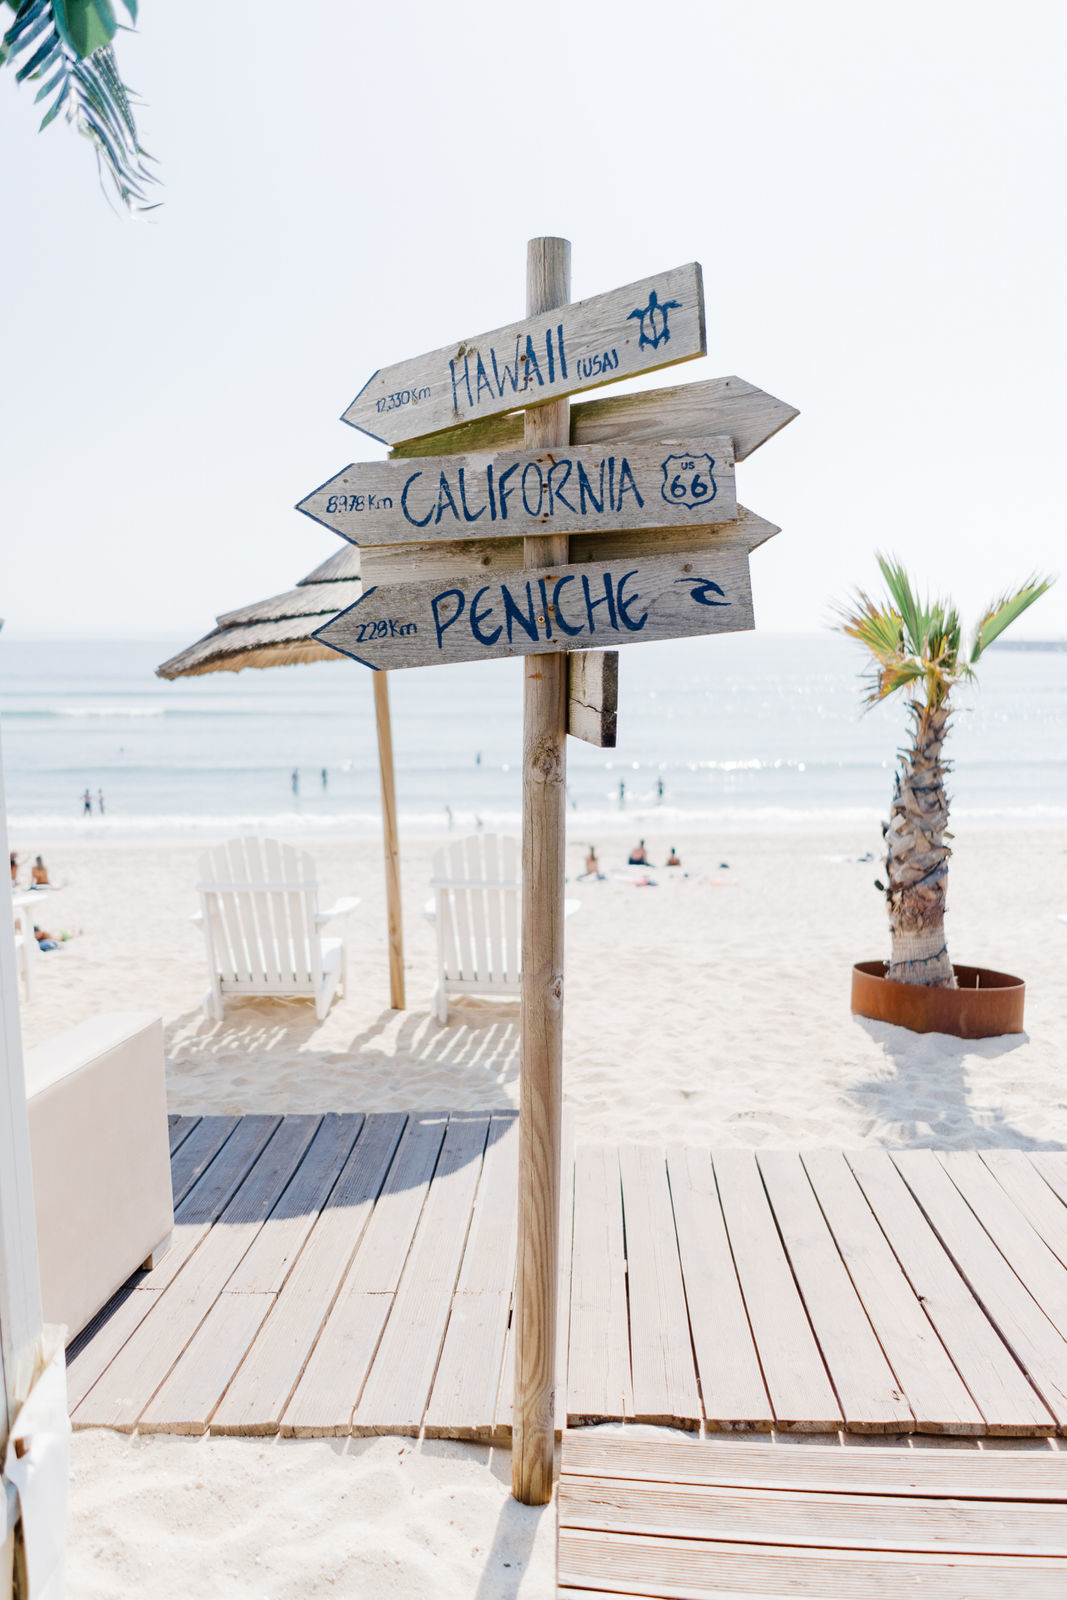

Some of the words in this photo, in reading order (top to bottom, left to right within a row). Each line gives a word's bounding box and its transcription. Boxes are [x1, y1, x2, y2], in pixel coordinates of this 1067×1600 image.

[449, 324, 568, 411] HAWAII
[577, 348, 619, 380] (USA)
[401, 456, 644, 527] CALIFORNIA
[670, 474, 709, 499] 66
[680, 461, 696, 471] US
[431, 570, 648, 649] PENICHE
